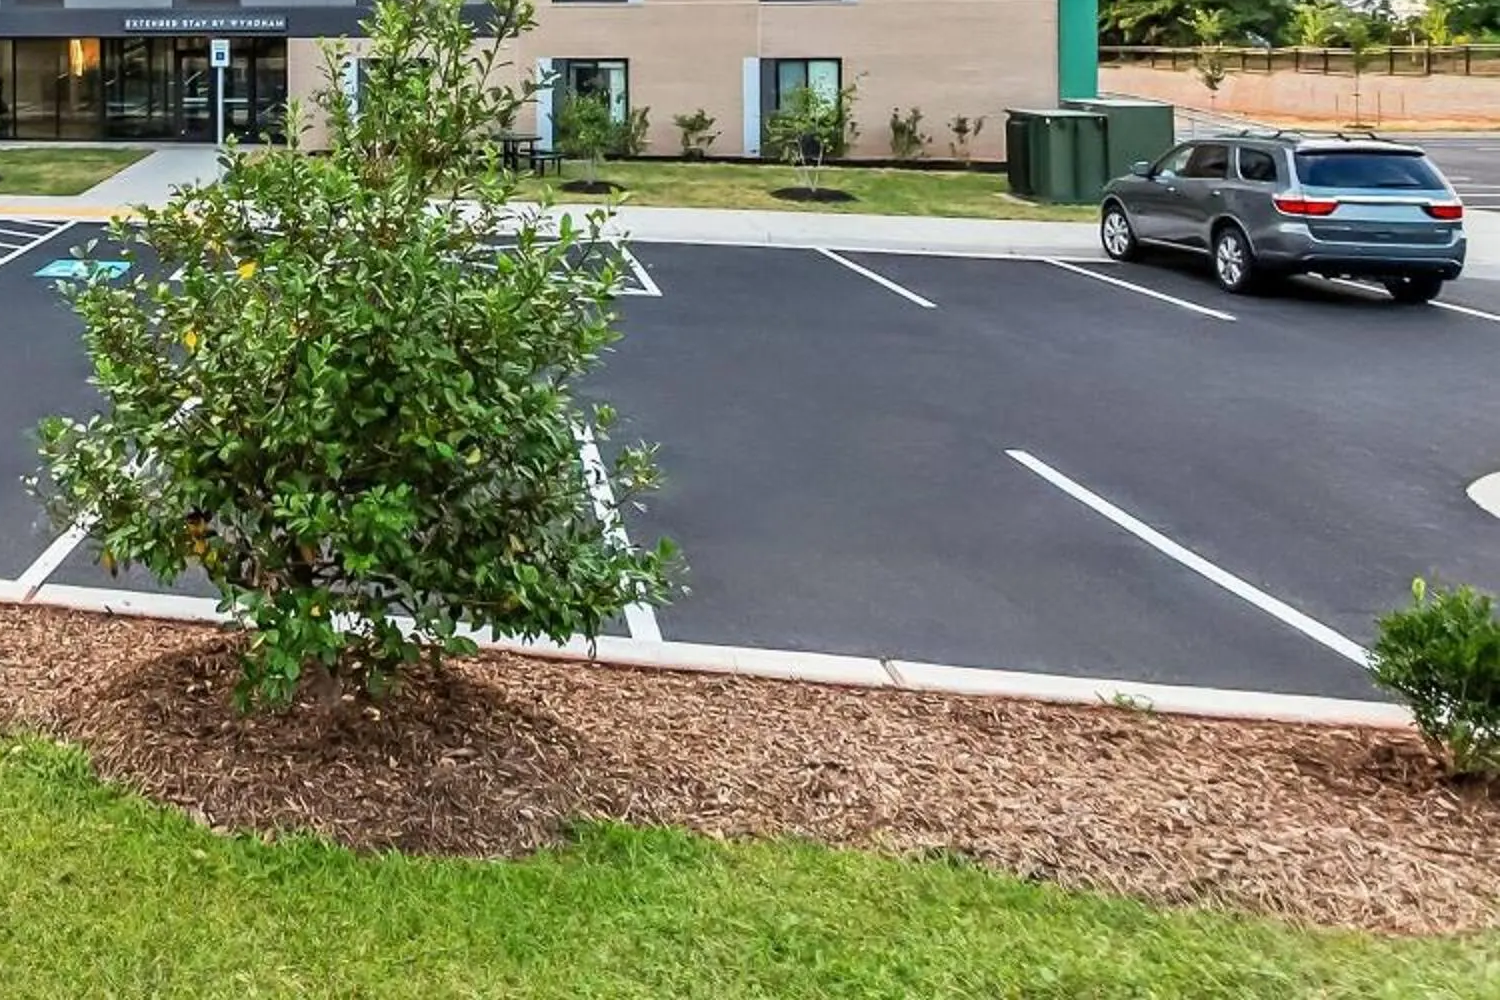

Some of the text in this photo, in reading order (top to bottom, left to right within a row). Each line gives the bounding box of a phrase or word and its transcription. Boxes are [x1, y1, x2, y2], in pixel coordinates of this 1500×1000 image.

[182, 19, 207, 28] STAY
[211, 19, 225, 28] BY
[230, 19, 285, 28] WYNDHAM
